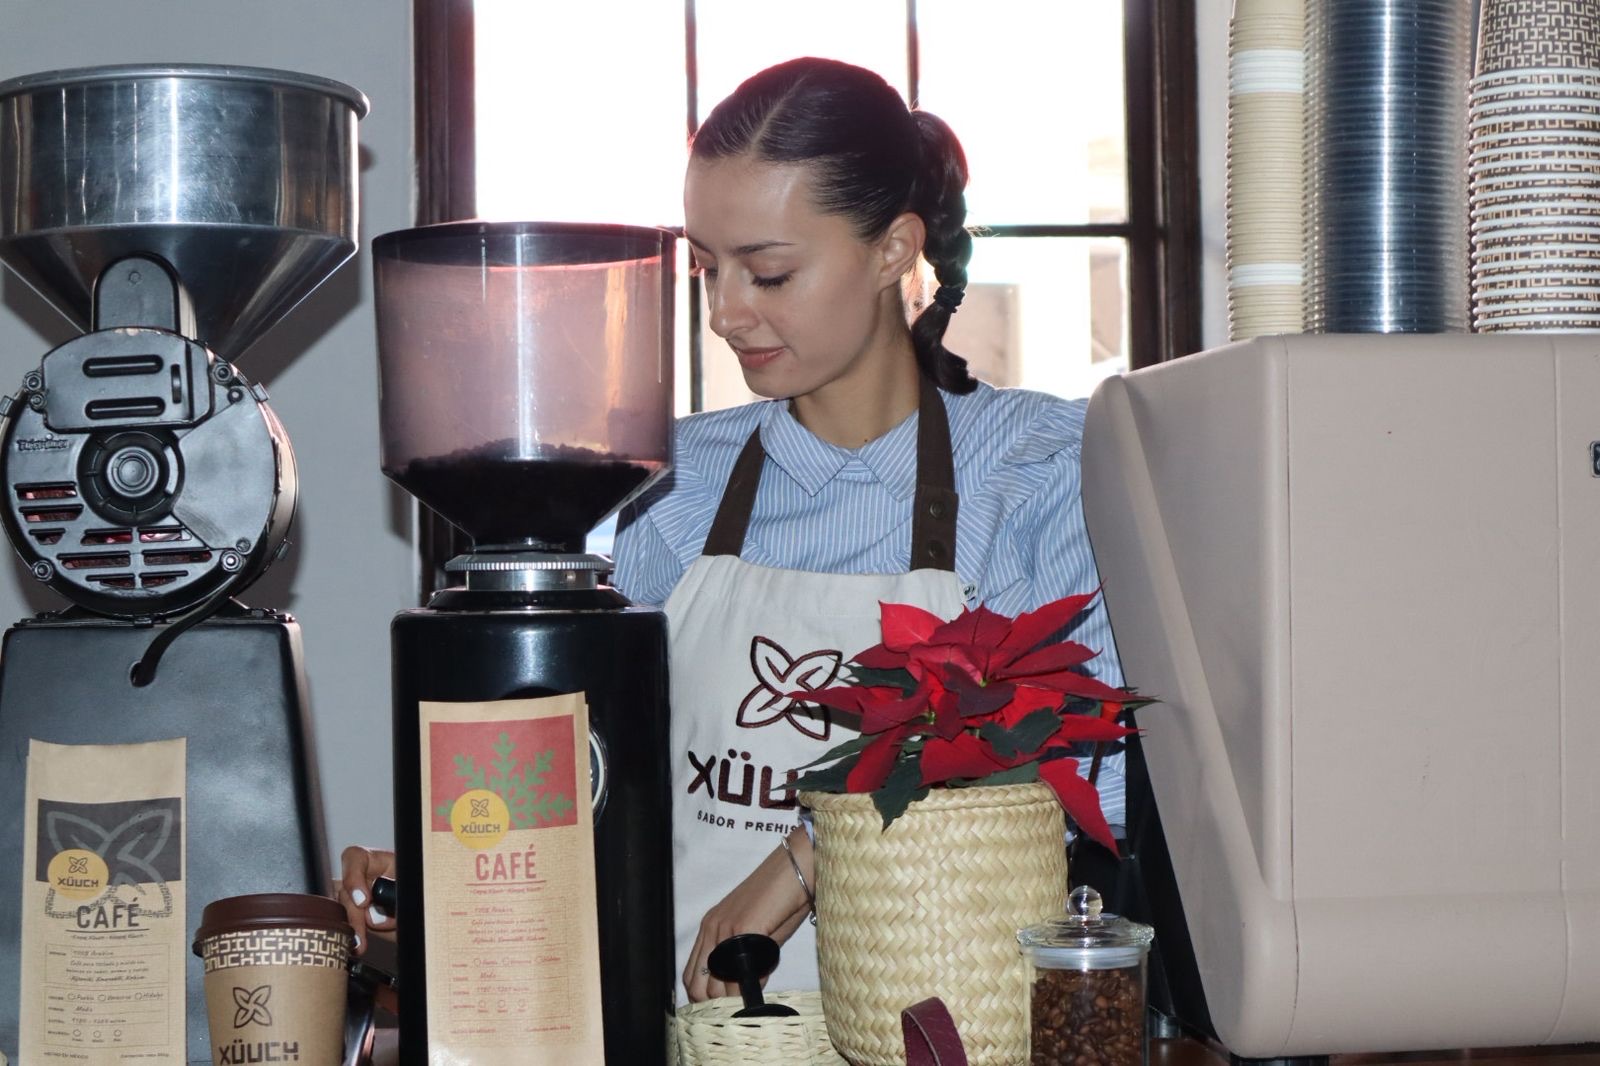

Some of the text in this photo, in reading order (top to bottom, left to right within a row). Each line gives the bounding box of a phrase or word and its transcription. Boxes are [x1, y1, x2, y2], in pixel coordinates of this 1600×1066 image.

[687, 748, 799, 811] XÜU
[460, 821, 501, 834] XÜUCH
[697, 810, 797, 834] SABOR PREHIS
[475, 843, 537, 881] CAFÉ
[57, 876, 99, 888] XÜUCH
[76, 897, 140, 929] CAFÉ
[219, 1039, 299, 1066] XÜUCH
